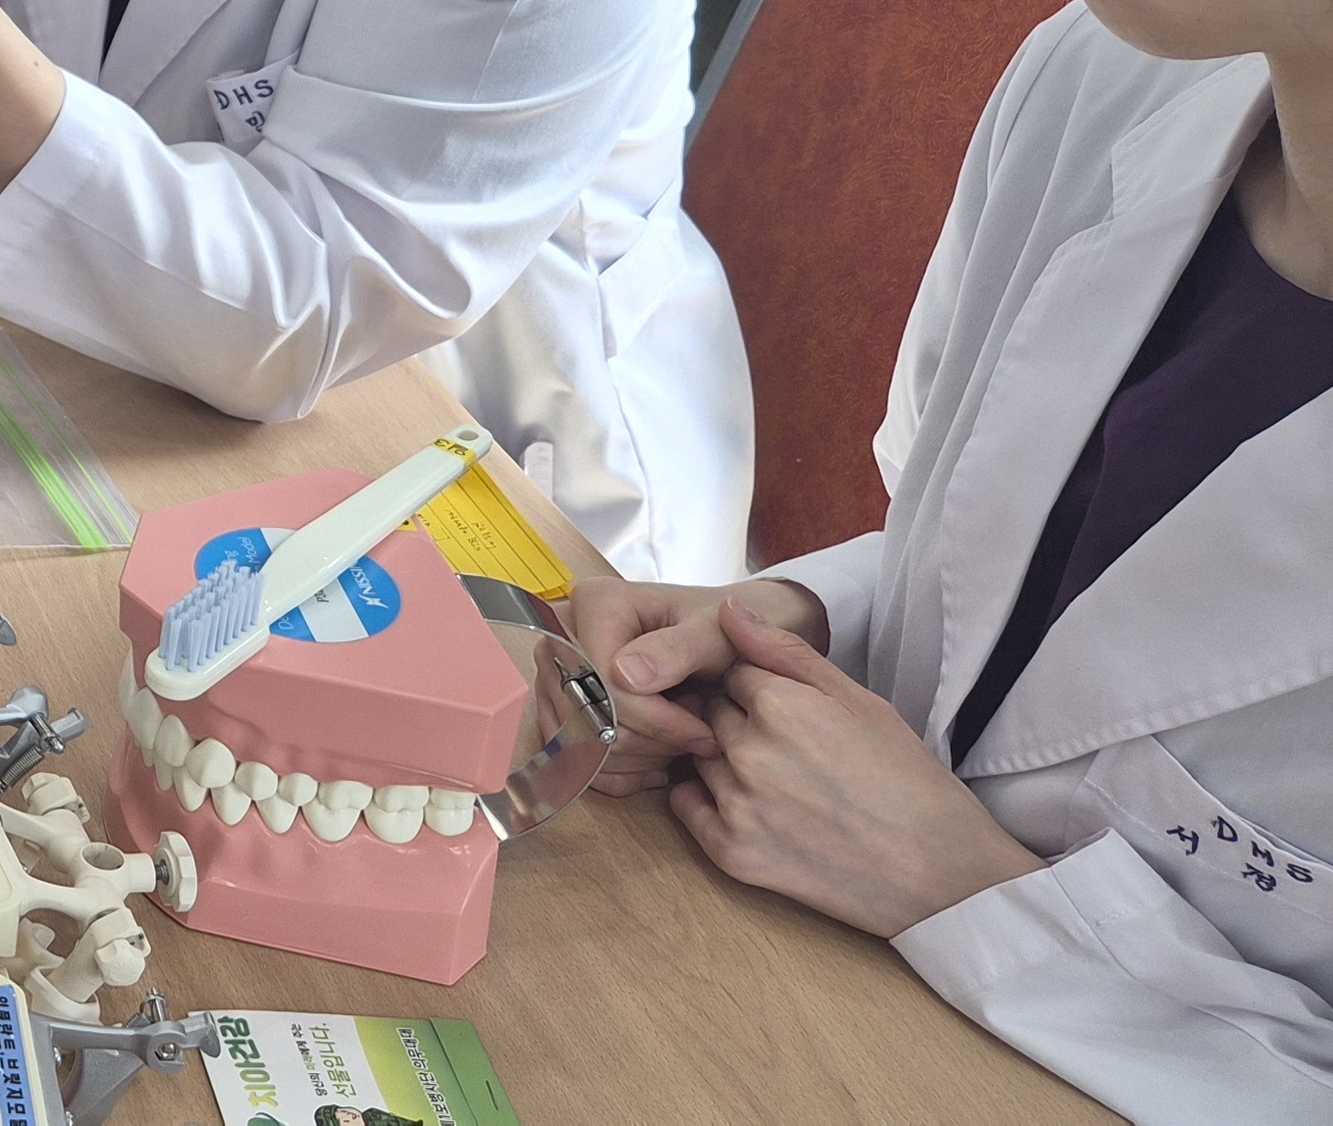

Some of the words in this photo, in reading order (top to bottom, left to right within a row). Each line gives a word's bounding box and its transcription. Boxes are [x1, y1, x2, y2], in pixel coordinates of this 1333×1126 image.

[215, 78, 274, 110] DHS
[290, 1023, 305, 1039] 주는
[398, 1028, 430, 1070] 의무대대
[217, 1015, 279, 1108] 치아건강
[309, 1022, 357, 1098] 선물입니다.
[308, 1073, 328, 1097] 당신의
